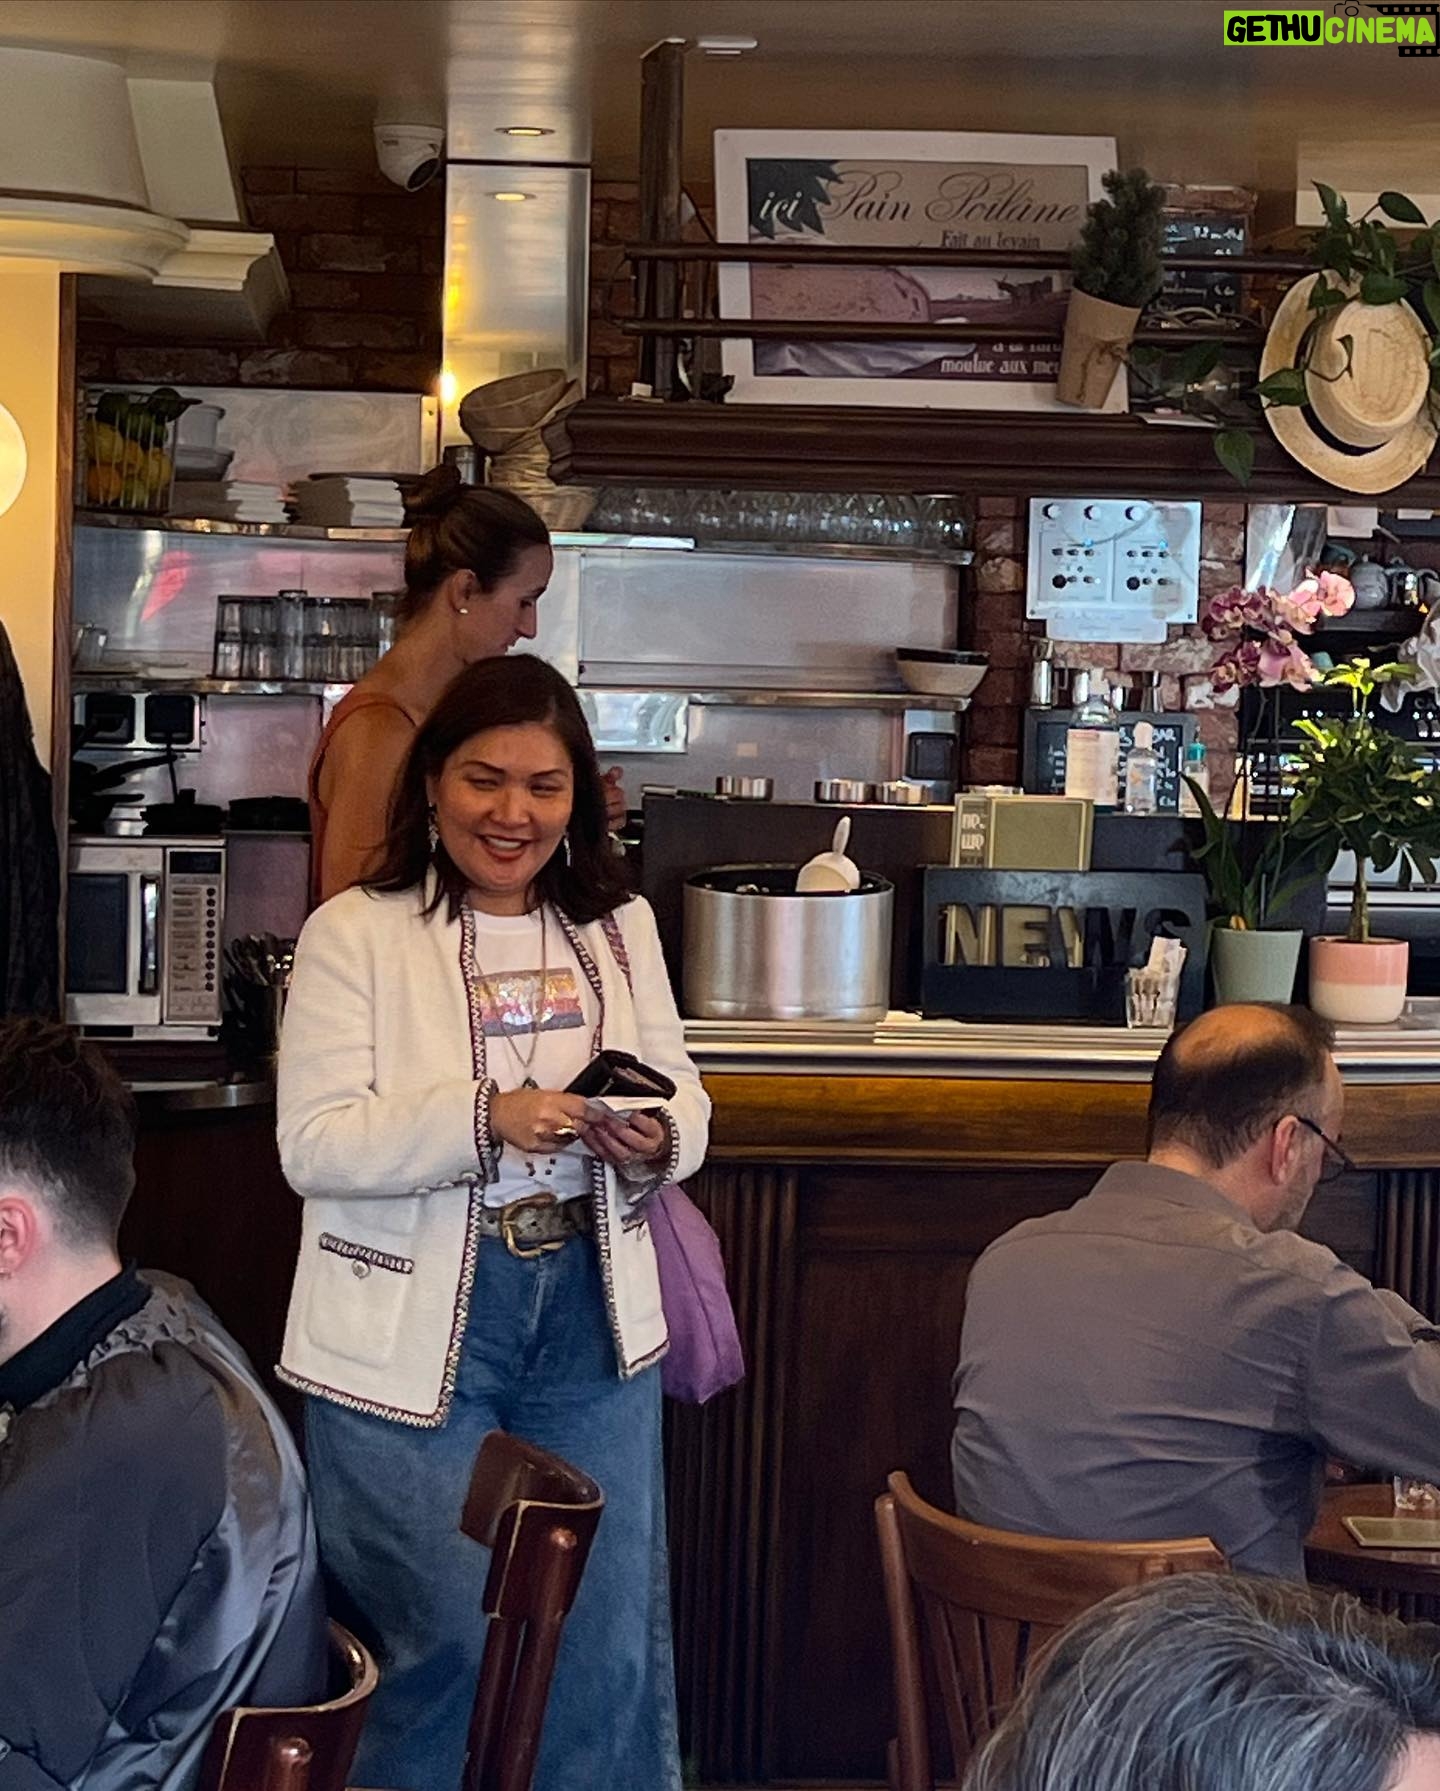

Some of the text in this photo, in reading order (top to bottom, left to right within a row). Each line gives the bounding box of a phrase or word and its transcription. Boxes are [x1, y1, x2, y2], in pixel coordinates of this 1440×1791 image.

[759, 191, 802, 221] ici
[817, 170, 911, 221] Pain
[1000, 360, 1028, 374] aux
